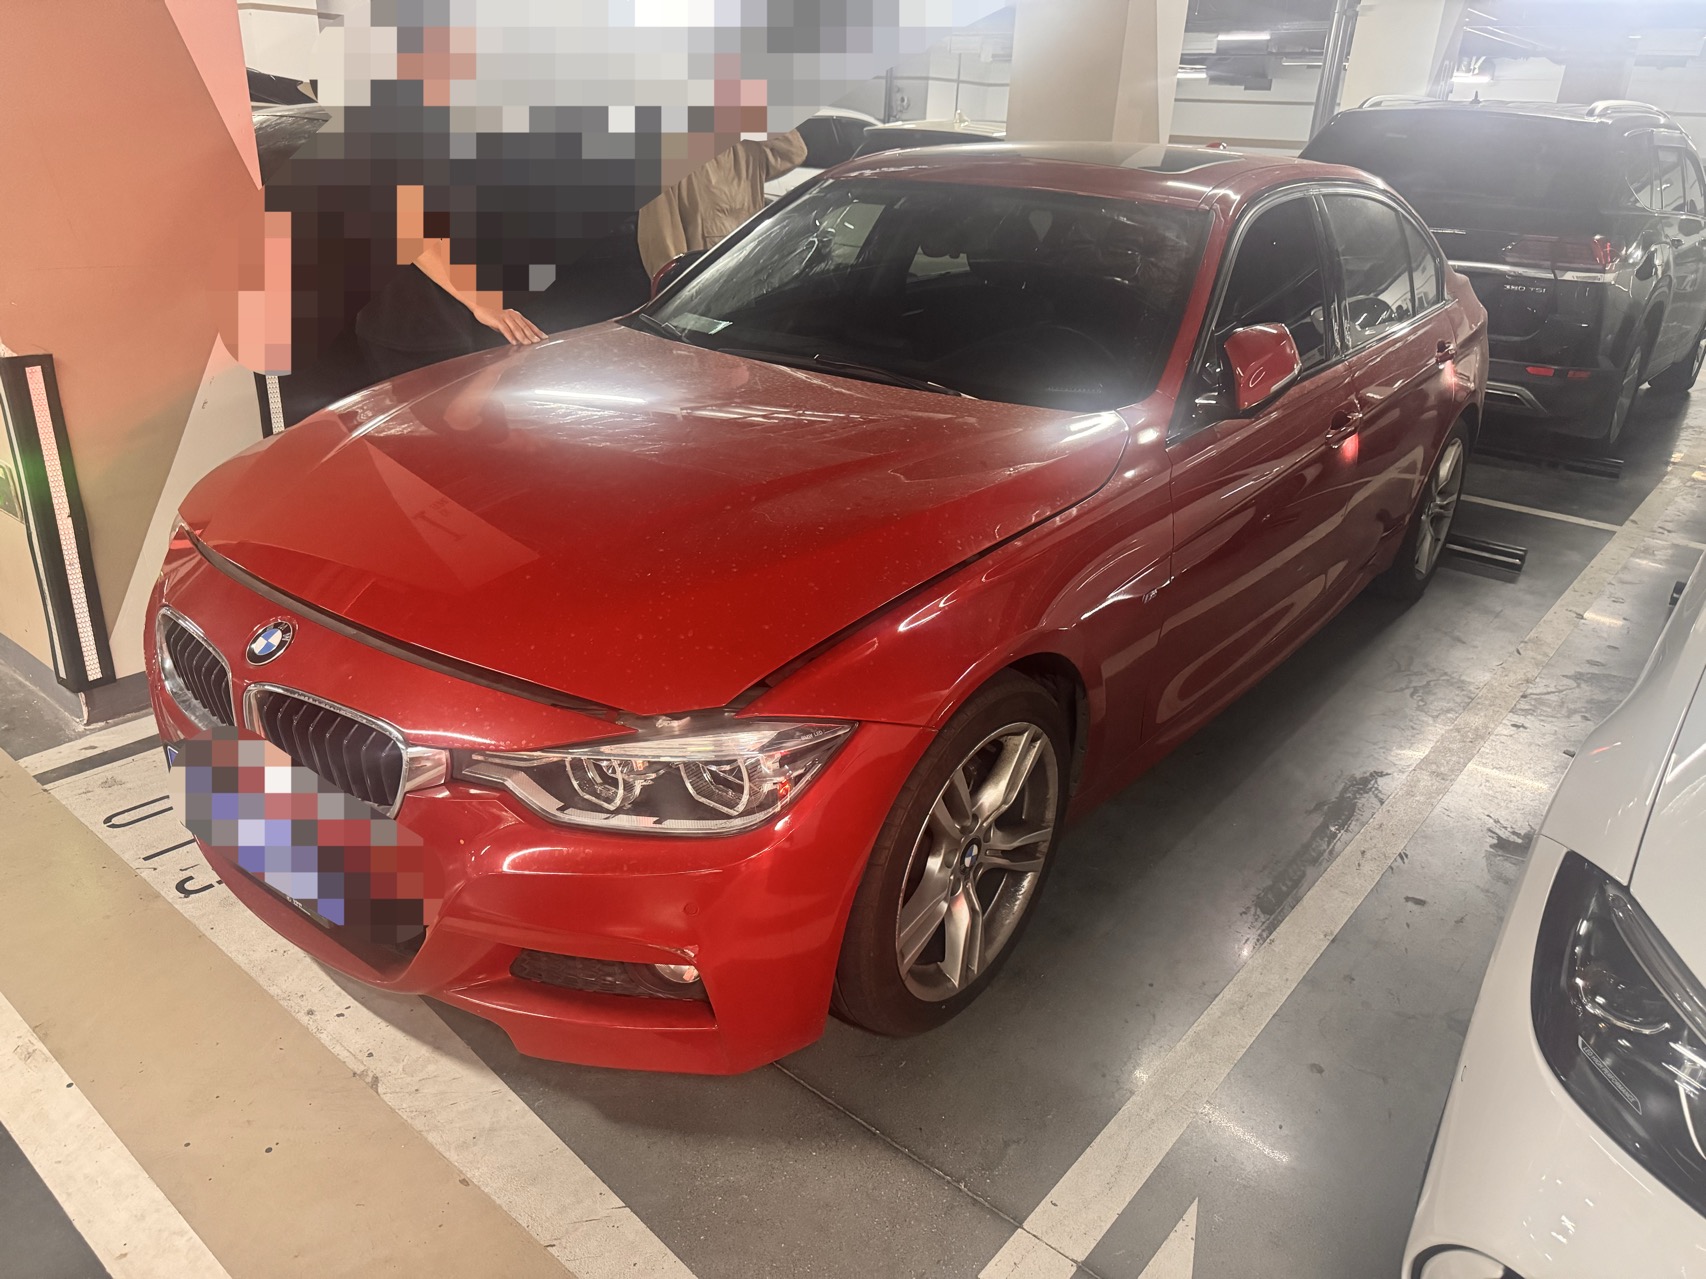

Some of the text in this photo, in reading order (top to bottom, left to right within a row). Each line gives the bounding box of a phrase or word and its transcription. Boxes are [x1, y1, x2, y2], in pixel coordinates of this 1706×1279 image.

[1583, 1046, 1636, 1103] LED HIGH PERFORMANCE
